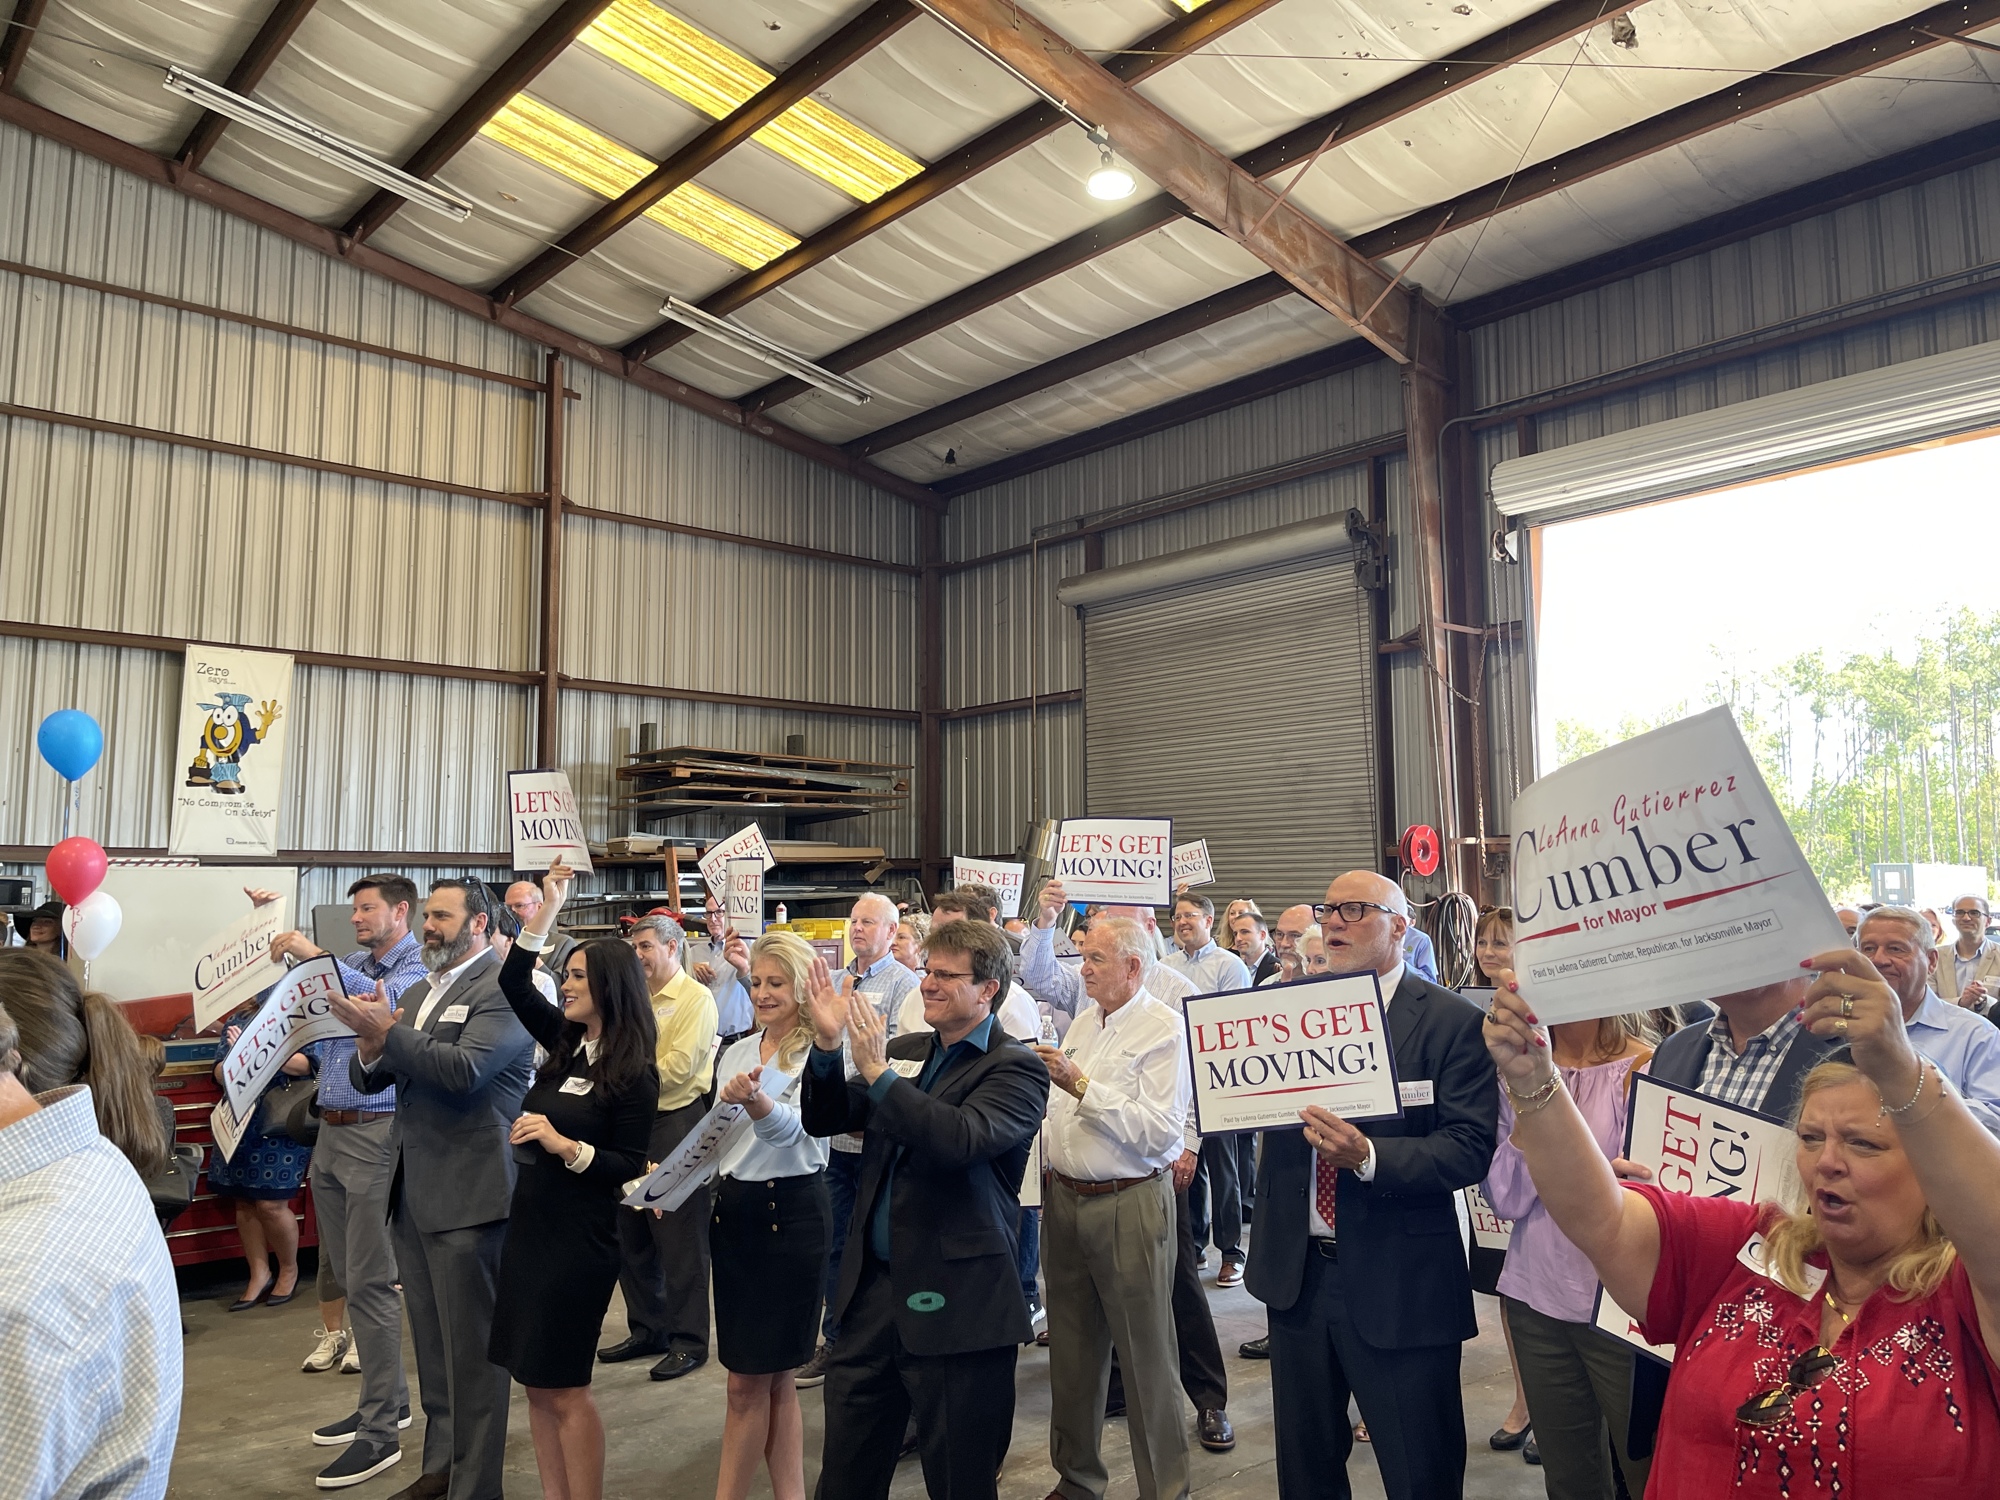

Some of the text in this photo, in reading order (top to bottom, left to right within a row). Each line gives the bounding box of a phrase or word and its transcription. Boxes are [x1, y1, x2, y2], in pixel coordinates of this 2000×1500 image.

[197, 662, 230, 677] Zero
[225, 808, 238, 816] On
[514, 790, 562, 814] LET'S
[1538, 775, 1737, 853] LeAnna Gutierrez
[703, 831, 761, 879] LET'S GET
[1060, 834, 1167, 855] LET'S GET
[1181, 848, 1203, 862] GET
[955, 866, 1022, 886] LET'S GET
[1059, 857, 1162, 879] MOVING!
[1514, 818, 1761, 924] Cumber
[737, 875, 761, 892] GET
[1583, 903, 1657, 931] for Mayor
[194, 929, 276, 991] Cumber
[1532, 917, 1773, 979] Paid by LeAnna Gutierrez Cumber, Republican, for Jacksonville Mayor
[227, 1011, 277, 1084] LET'S
[280, 972, 335, 1012] GET
[1194, 1002, 1375, 1053] LET'S GET
[1205, 1041, 1378, 1090] MOVING!
[1329, 1104, 1356, 1112] Jacksonville
[1401, 1090, 1431, 1099] umber
[643, 1106, 739, 1203] Cumb
[1658, 1095, 1702, 1197] GET
